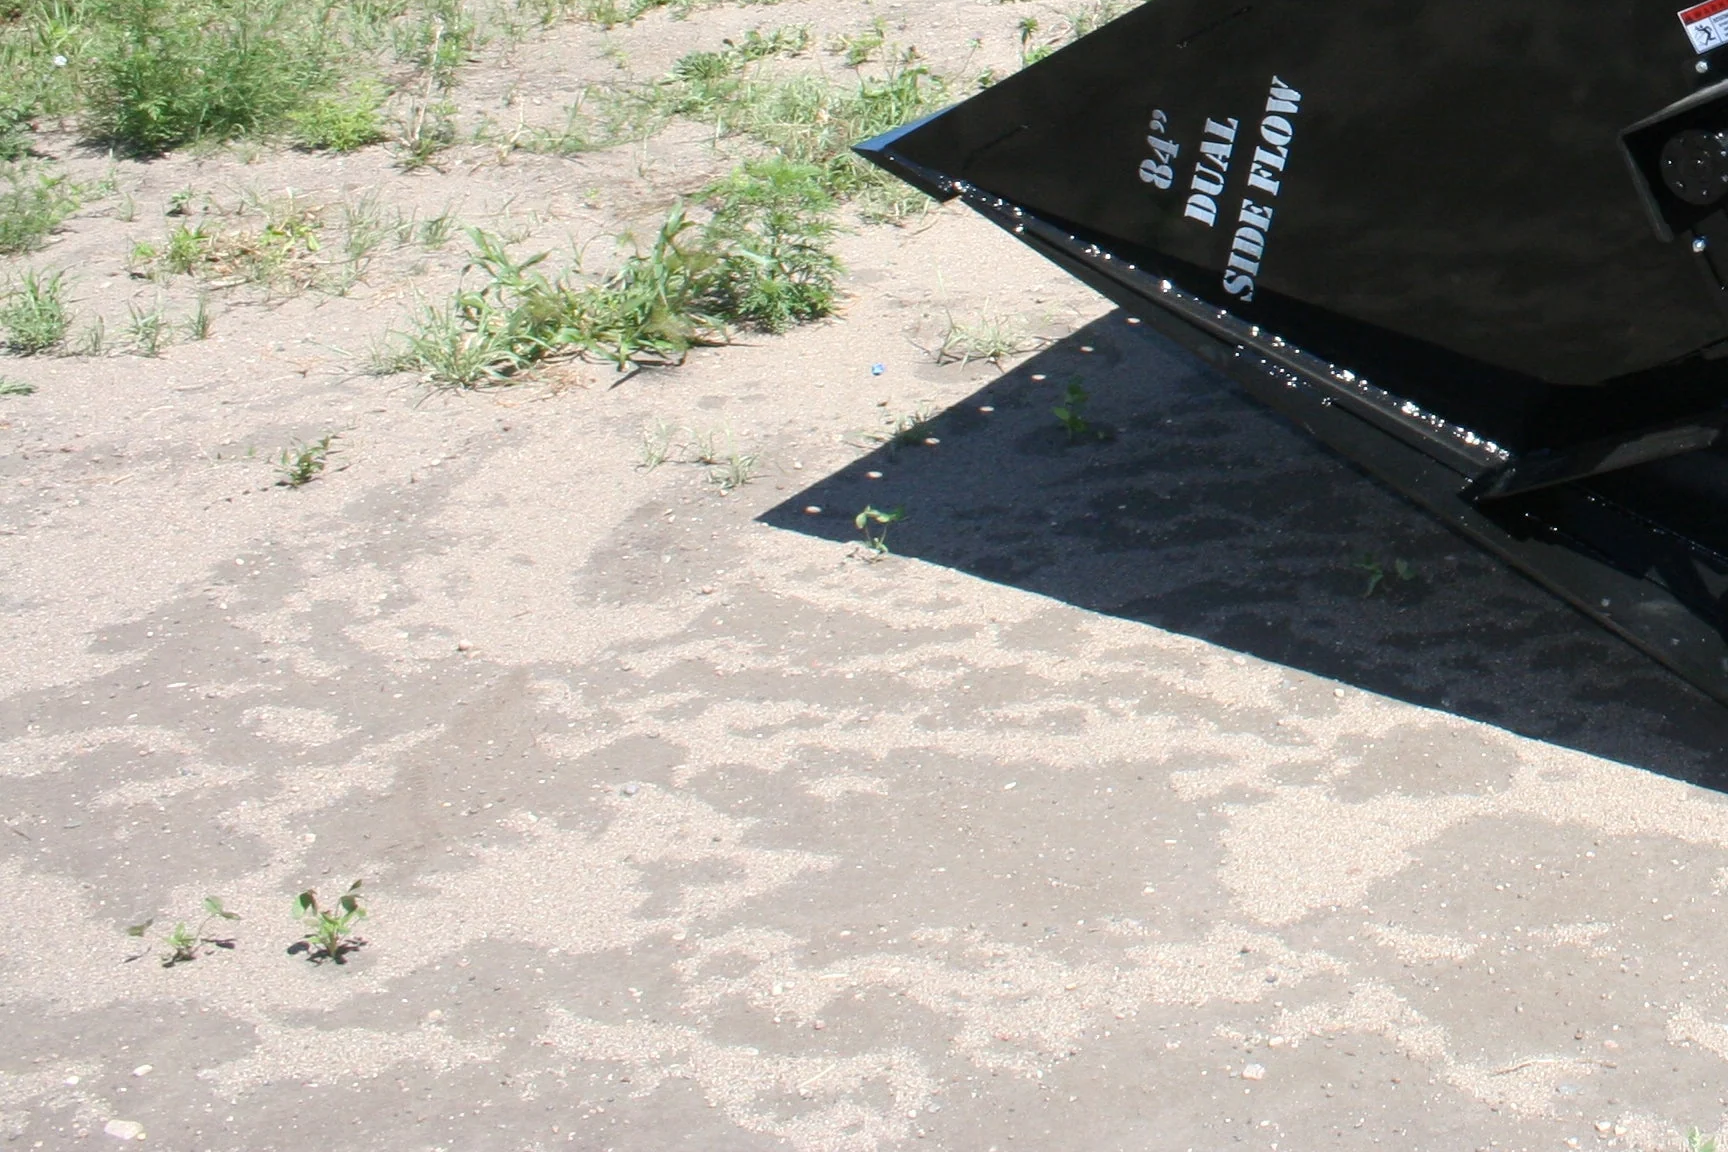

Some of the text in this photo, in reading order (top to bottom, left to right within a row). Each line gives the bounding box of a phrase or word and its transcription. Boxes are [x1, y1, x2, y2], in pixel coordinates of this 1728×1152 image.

[1184, 117, 1239, 227] DUAL
[1222, 75, 1302, 302] SIDE FLOW
